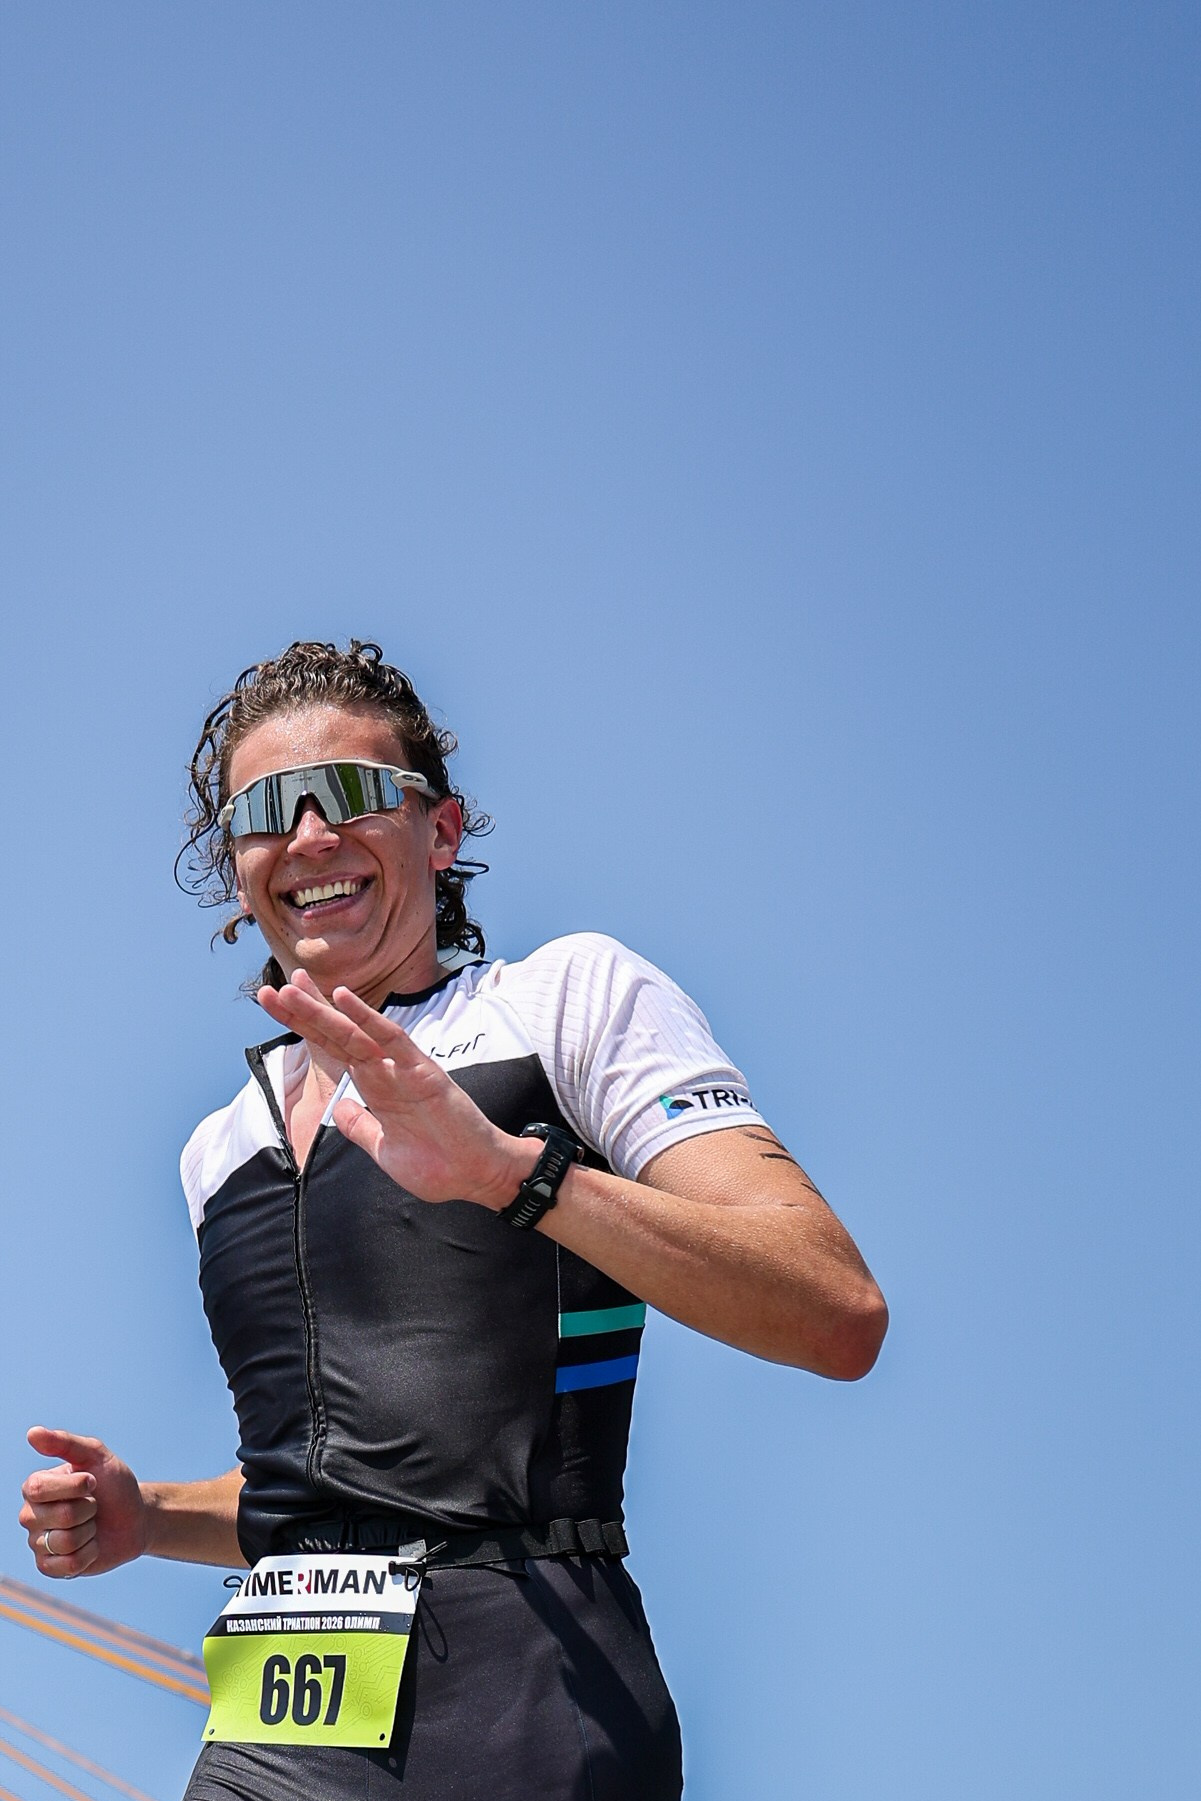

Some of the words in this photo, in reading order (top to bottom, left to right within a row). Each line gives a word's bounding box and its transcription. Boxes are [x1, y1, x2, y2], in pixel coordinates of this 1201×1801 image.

[429, 1033, 486, 1058] I-FIT
[692, 1089, 757, 1112] TRI-
[226, 1616, 282, 1632] КАЗАНСКИЙ
[282, 1617, 320, 1631] ТРИАТЛОН
[321, 1616, 343, 1630] 2026
[344, 1616, 381, 1630] ОЛИМП
[259, 1654, 346, 1726] 667
